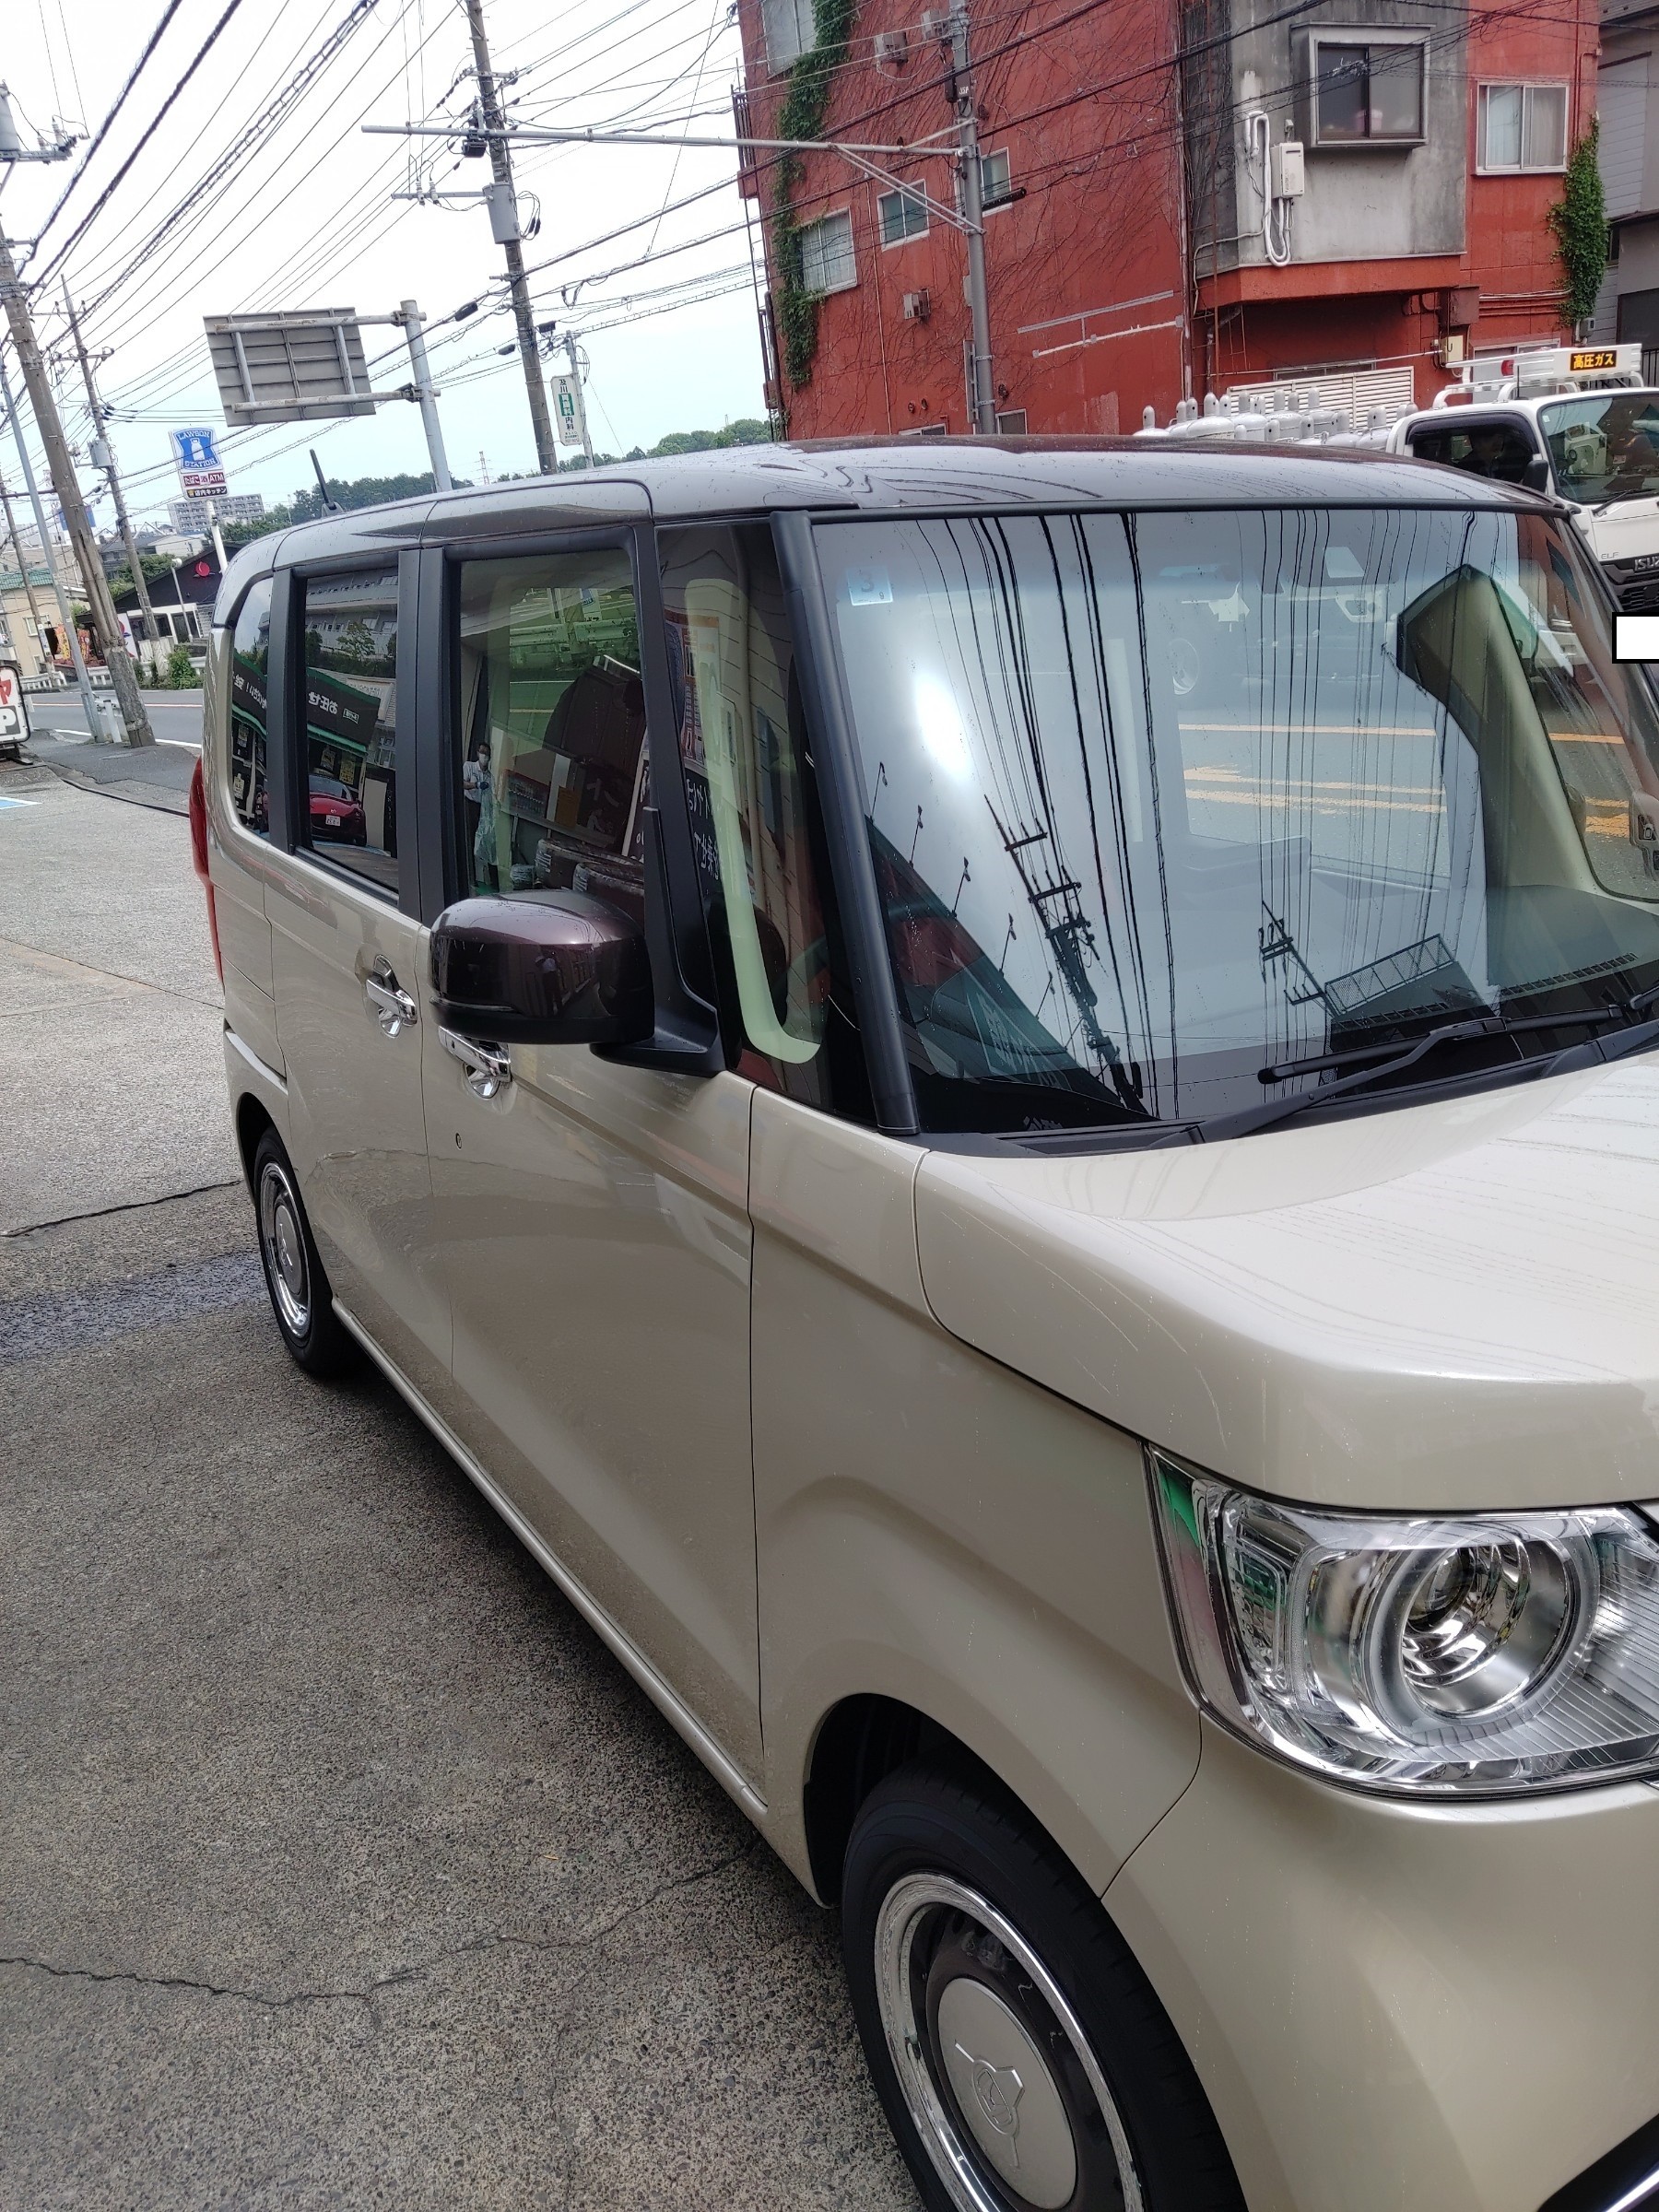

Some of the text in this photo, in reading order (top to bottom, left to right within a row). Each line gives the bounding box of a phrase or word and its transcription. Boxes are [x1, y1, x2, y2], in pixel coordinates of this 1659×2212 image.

[1573, 353, 1614, 369] 高圧ガス
[178, 430, 210, 440] LAWSON
[184, 458, 217, 467] STATION
[209, 474, 225, 484] ATM
[194, 487, 228, 497] 店内キッチン
[1600, 551, 1620, 559] ELF
